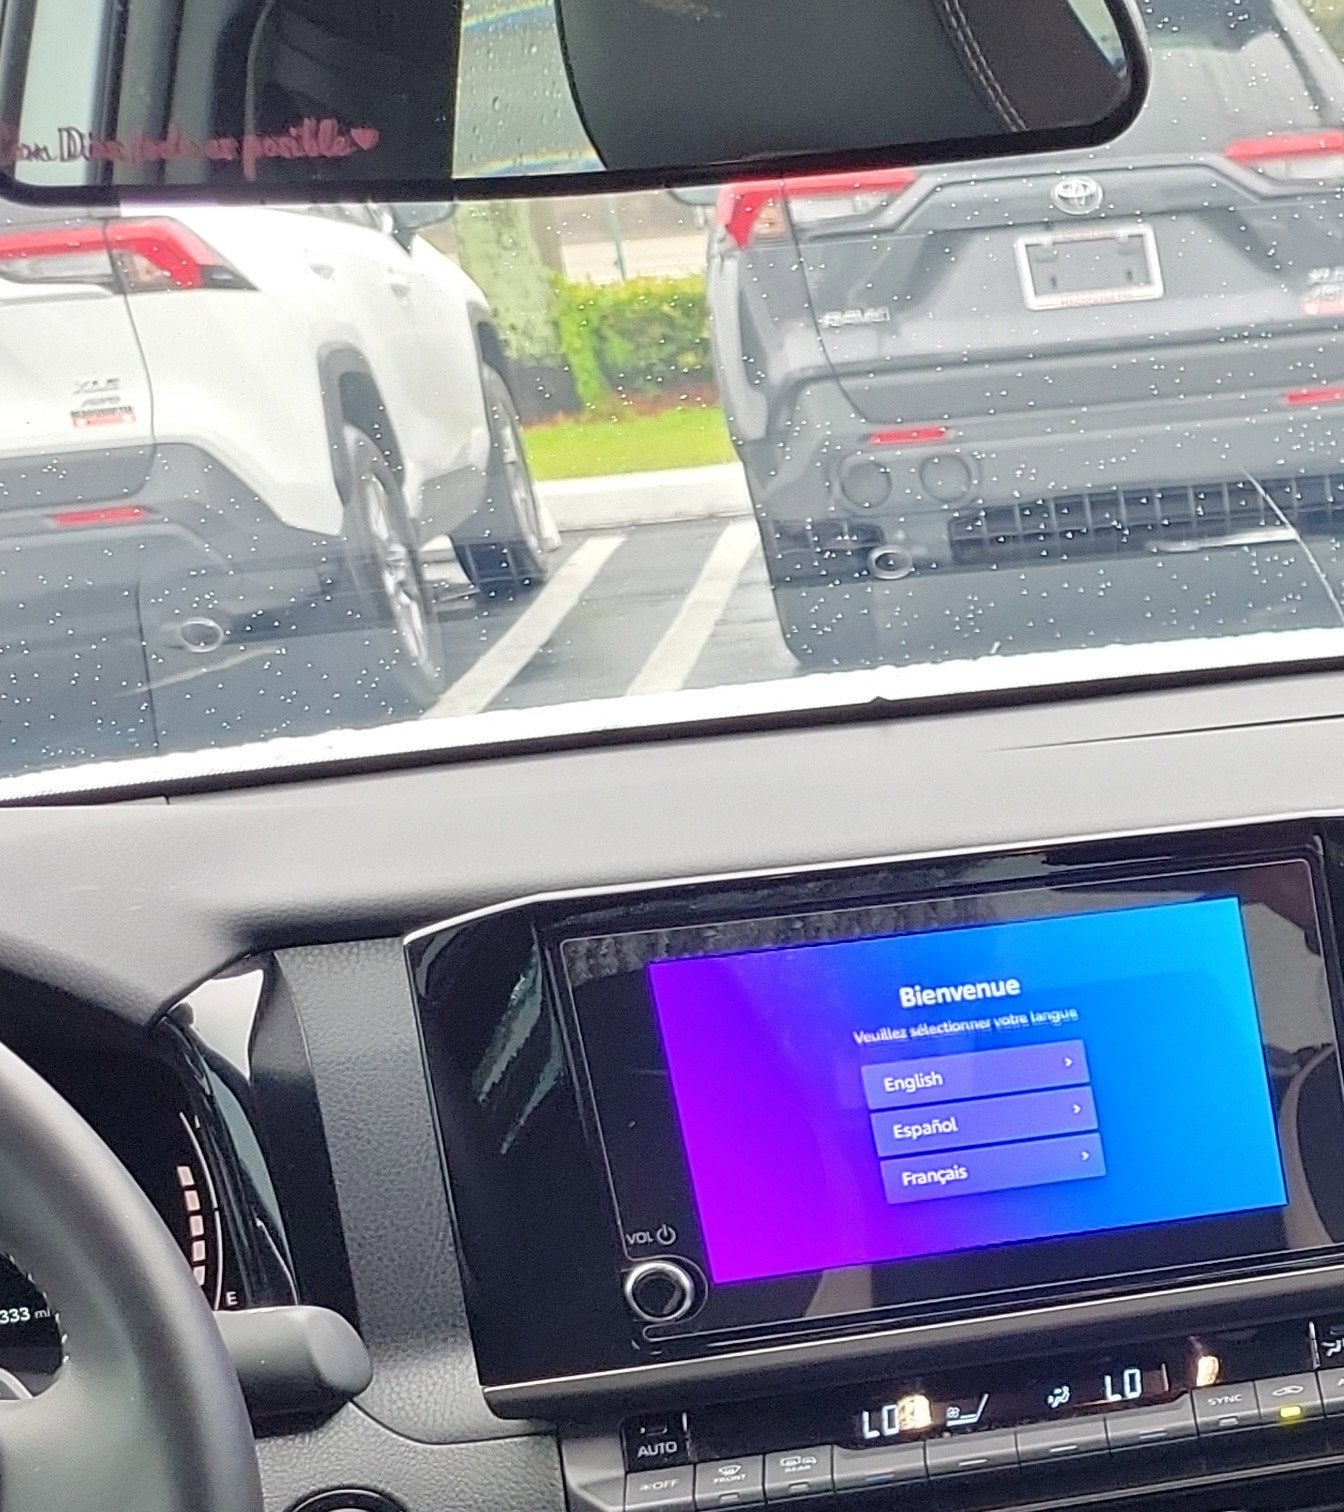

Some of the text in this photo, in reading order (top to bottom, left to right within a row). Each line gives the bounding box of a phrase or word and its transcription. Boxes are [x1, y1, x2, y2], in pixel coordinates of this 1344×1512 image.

[899, 978, 1021, 1008] Bienvenue
[852, 1008, 1079, 1045] Veuillez sélectionner votre langue
[883, 1071, 943, 1093] English
[893, 1116, 958, 1139] Español
[902, 1164, 968, 1186] Français
[625, 1230, 654, 1245] VOL
[226, 1291, 238, 1306] E
[1207, 1393, 1243, 1406] SYNC
[637, 1441, 678, 1458] AUTO
[652, 1478, 680, 1491] OFF
[711, 1473, 748, 1485] FRONT
